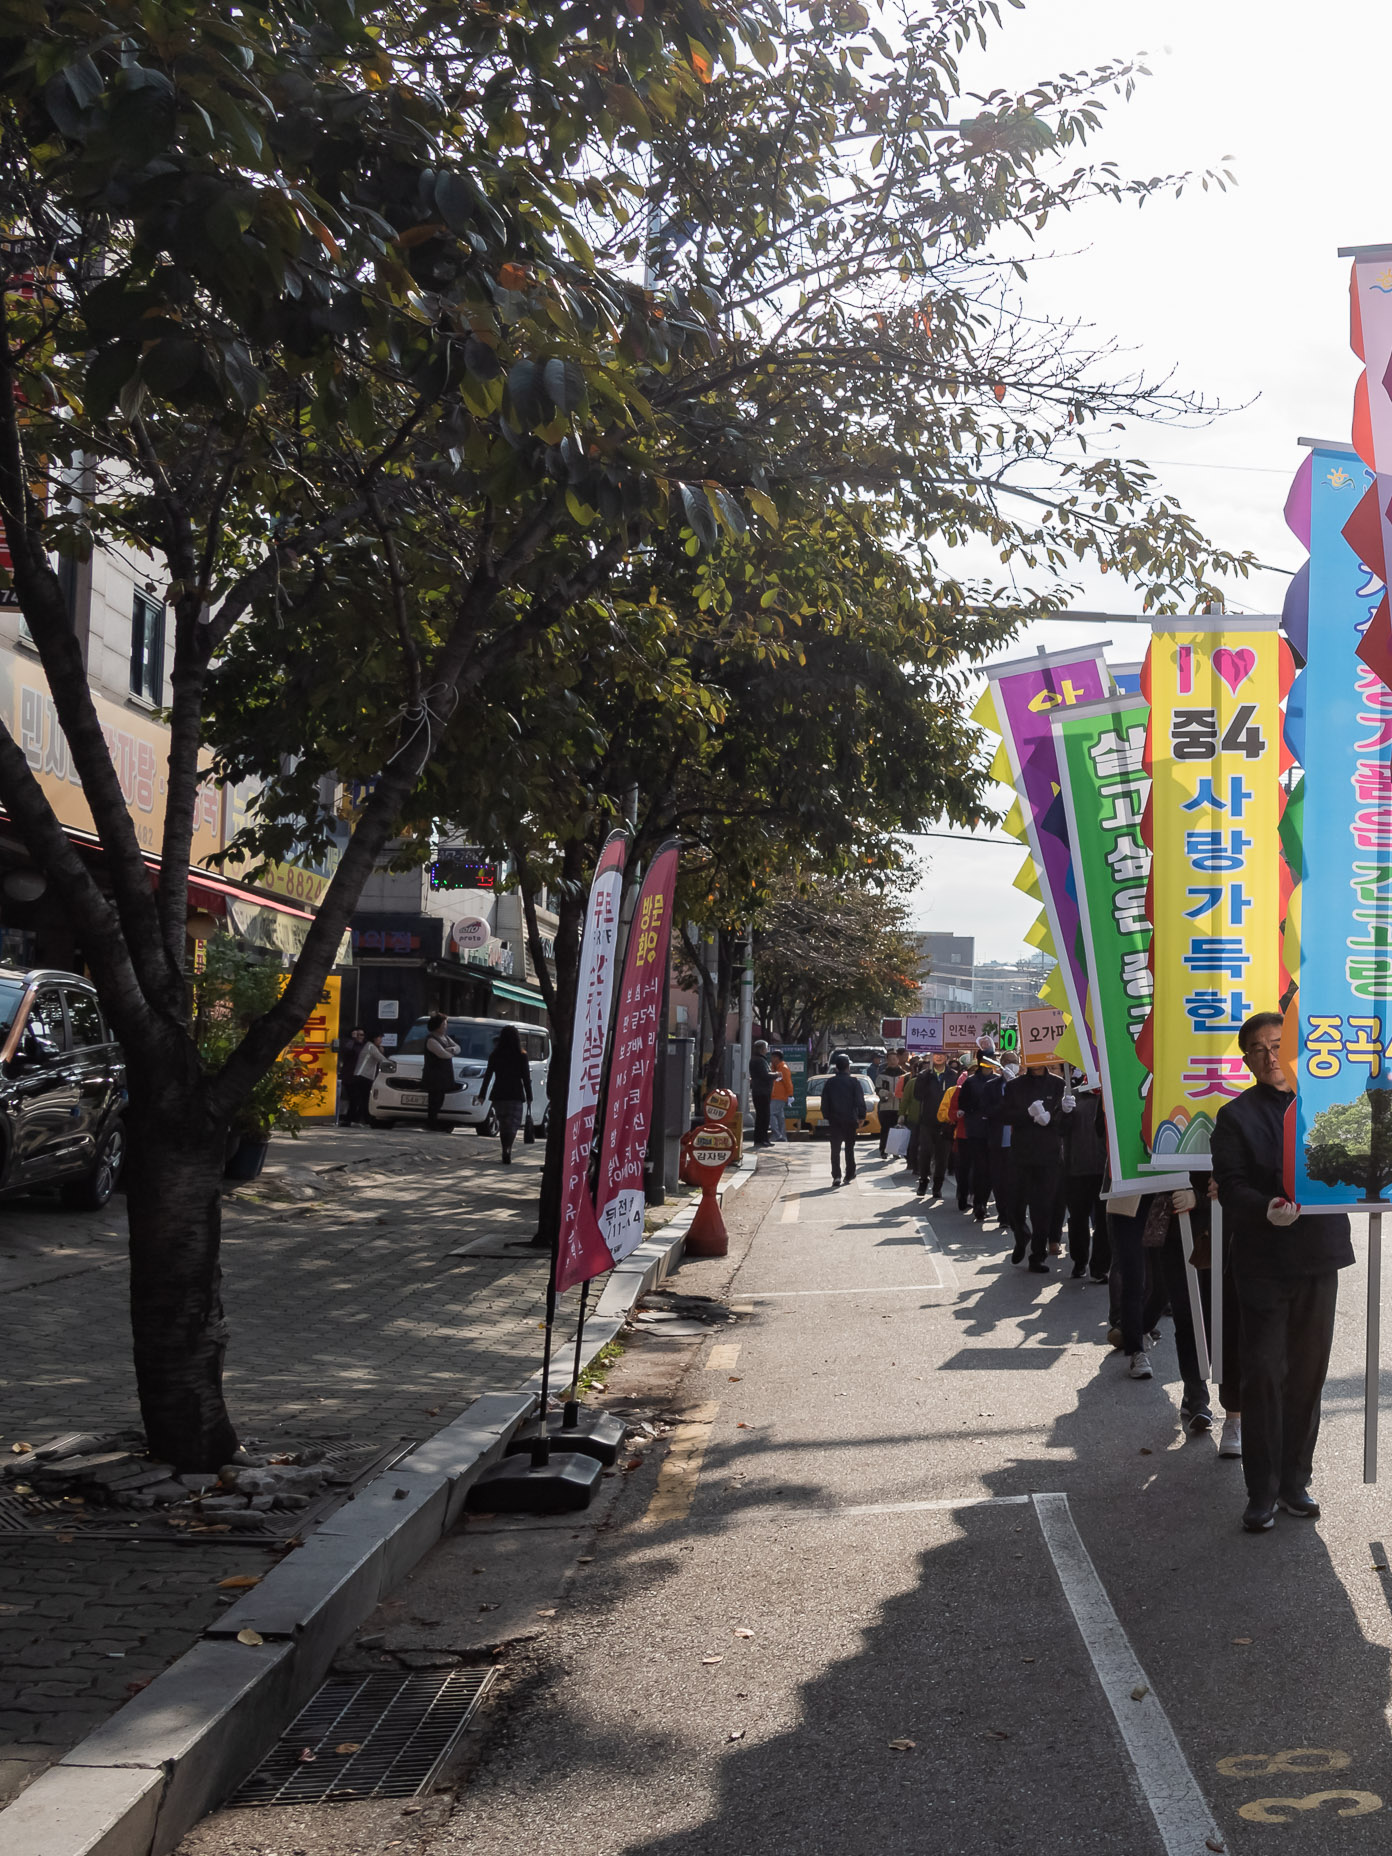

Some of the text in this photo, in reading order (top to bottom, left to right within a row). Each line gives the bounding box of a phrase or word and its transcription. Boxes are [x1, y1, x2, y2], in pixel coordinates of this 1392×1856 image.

[1171, 703, 1267, 761] 중4
[641, 894, 663, 930] 방문
[911, 1028, 937, 1039] 하수오
[949, 1024, 976, 1037] 인진쑥
[697, 1152, 727, 1161] 감자탕
